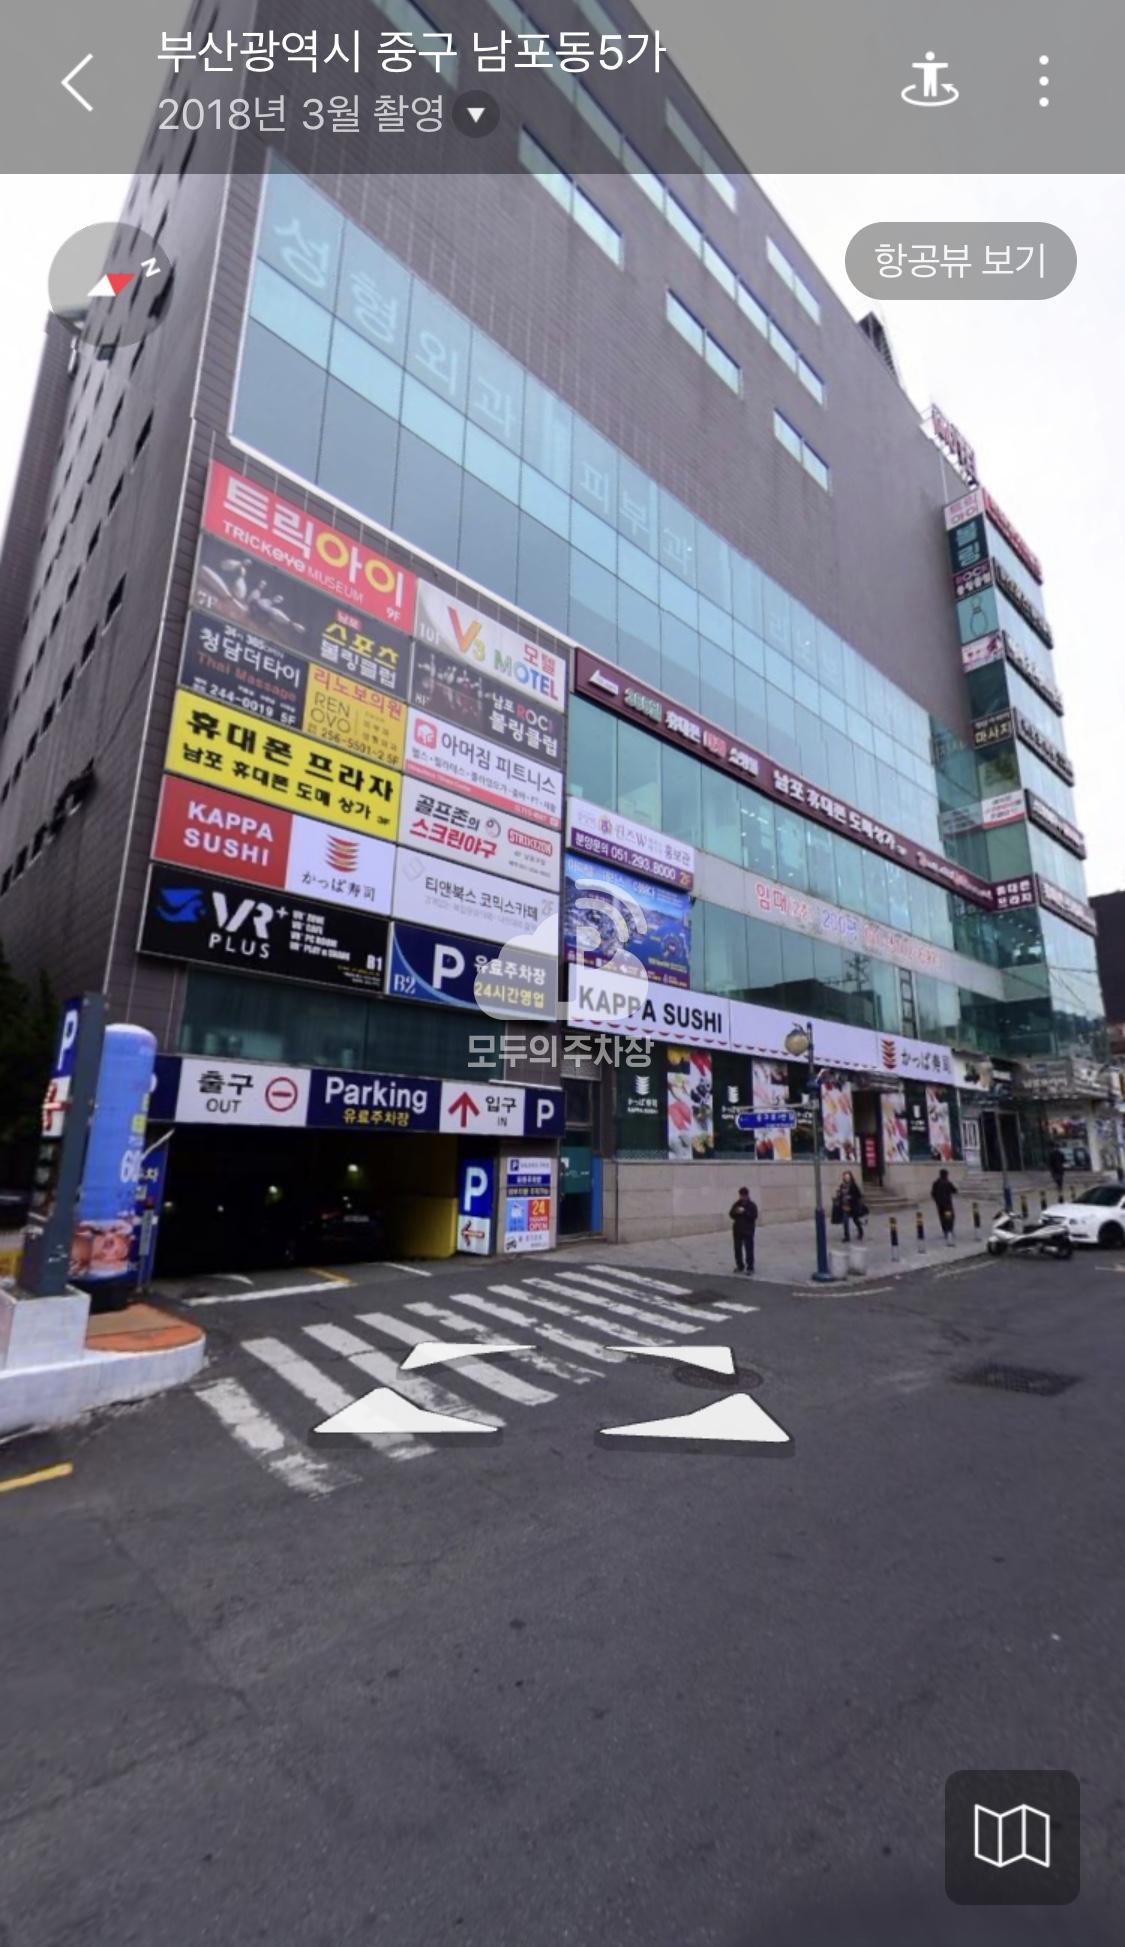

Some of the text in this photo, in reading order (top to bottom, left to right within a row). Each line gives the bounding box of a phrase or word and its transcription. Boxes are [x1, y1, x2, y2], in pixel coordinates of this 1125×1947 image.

[223, 476, 404, 609] 트릭아이
[307, 566, 365, 604] MUSEUM
[386, 606, 402, 622] 9F
[322, 622, 400, 671] 스포츠
[447, 606, 486, 662] V3
[200, 627, 300, 689] 청담더타이
[494, 649, 560, 701] MOTEL
[310, 707, 351, 735] OVO
[314, 691, 350, 718] REN
[489, 710, 558, 758] 볼링클럽
[186, 708, 292, 767] 휴대폰
[304, 751, 393, 802] 프라자
[441, 732, 491, 771] 아머짐
[496, 755, 556, 796] 피트니스
[183, 742, 222, 771] 남포
[232, 760, 289, 794] 휴대폰
[296, 780, 331, 807] 도매
[338, 796, 371, 821] 상가
[187, 800, 274, 843] KAPPA
[414, 794, 480, 833] 골프존의
[183, 828, 269, 867] SUSHI
[409, 818, 497, 859] 스크린야구
[425, 876, 477, 904] 티앤북스
[208, 931, 270, 959] PLUS
[366, 954, 383, 972] B1
[432, 943, 465, 990] P
[474, 954, 546, 985] 유료주차장
[474, 980, 544, 1009] 24시간영업
[578, 985, 722, 1034] KAPPA SUSHI
[197, 1069, 254, 1096] 출구
[325, 1076, 428, 1116] Parking
[206, 1097, 242, 1115] OUT
[342, 1107, 410, 1128] 유료주차장
[485, 1095, 517, 1115] 입구
[497, 1115, 508, 1128] IN
[536, 1099, 555, 1128] P
[464, 1166, 489, 1212] P
